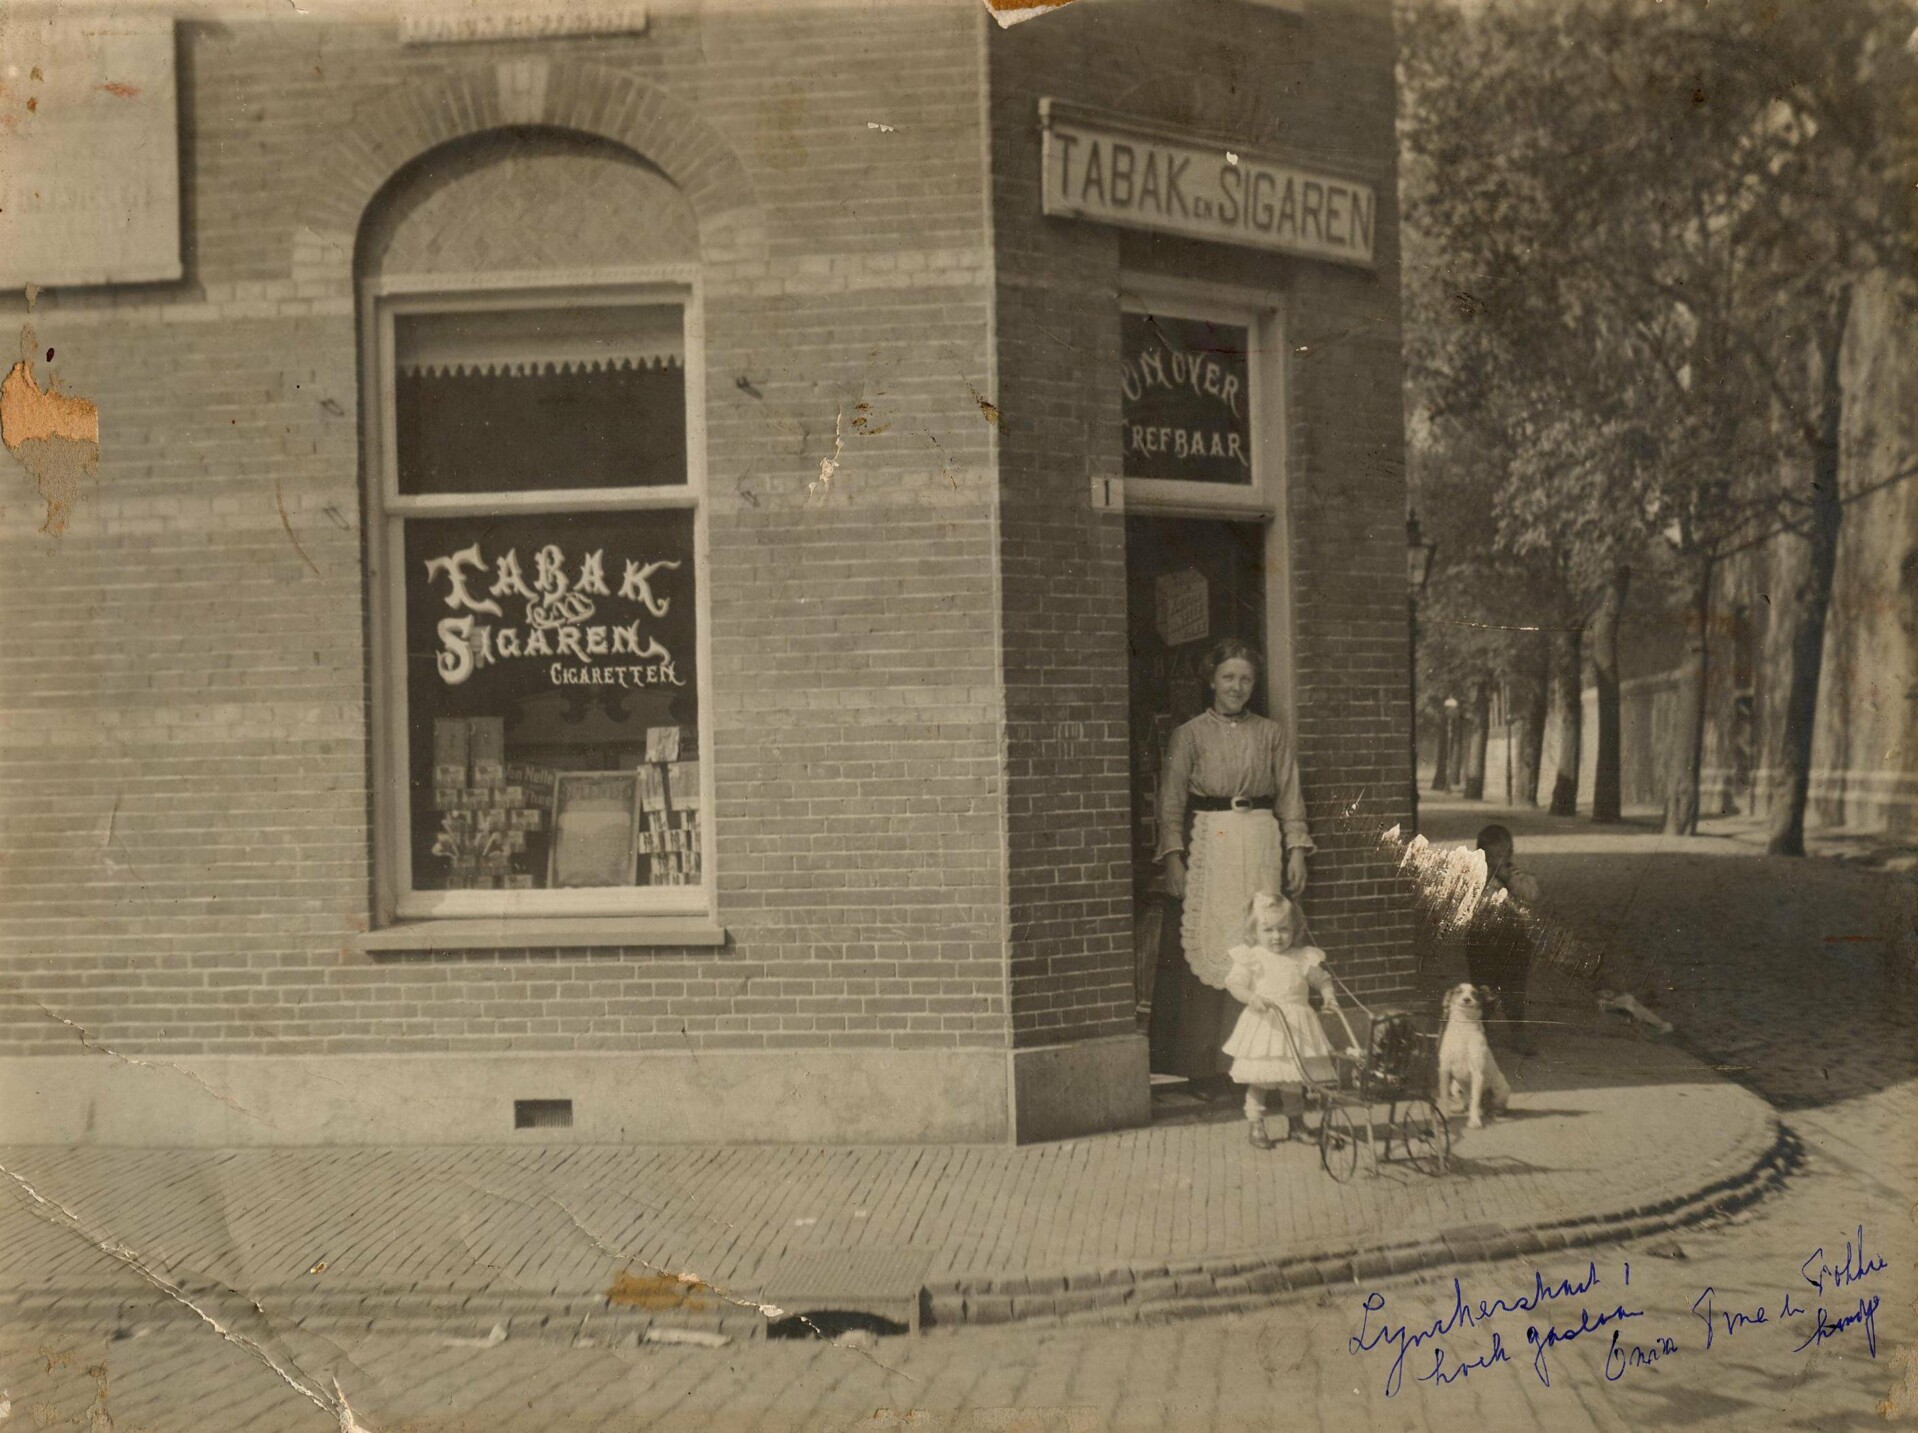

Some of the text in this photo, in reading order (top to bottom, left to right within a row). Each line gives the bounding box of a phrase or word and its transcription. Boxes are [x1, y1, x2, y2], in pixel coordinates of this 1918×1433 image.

[1054, 131, 1192, 218] TABAK
[1217, 164, 1375, 247] SIGAREN
[425, 542, 682, 618] TABAK
[436, 614, 671, 685] SIGAREN
[550, 661, 687, 688] CIGARETTEN
[524, 765, 554, 785] Nelle
